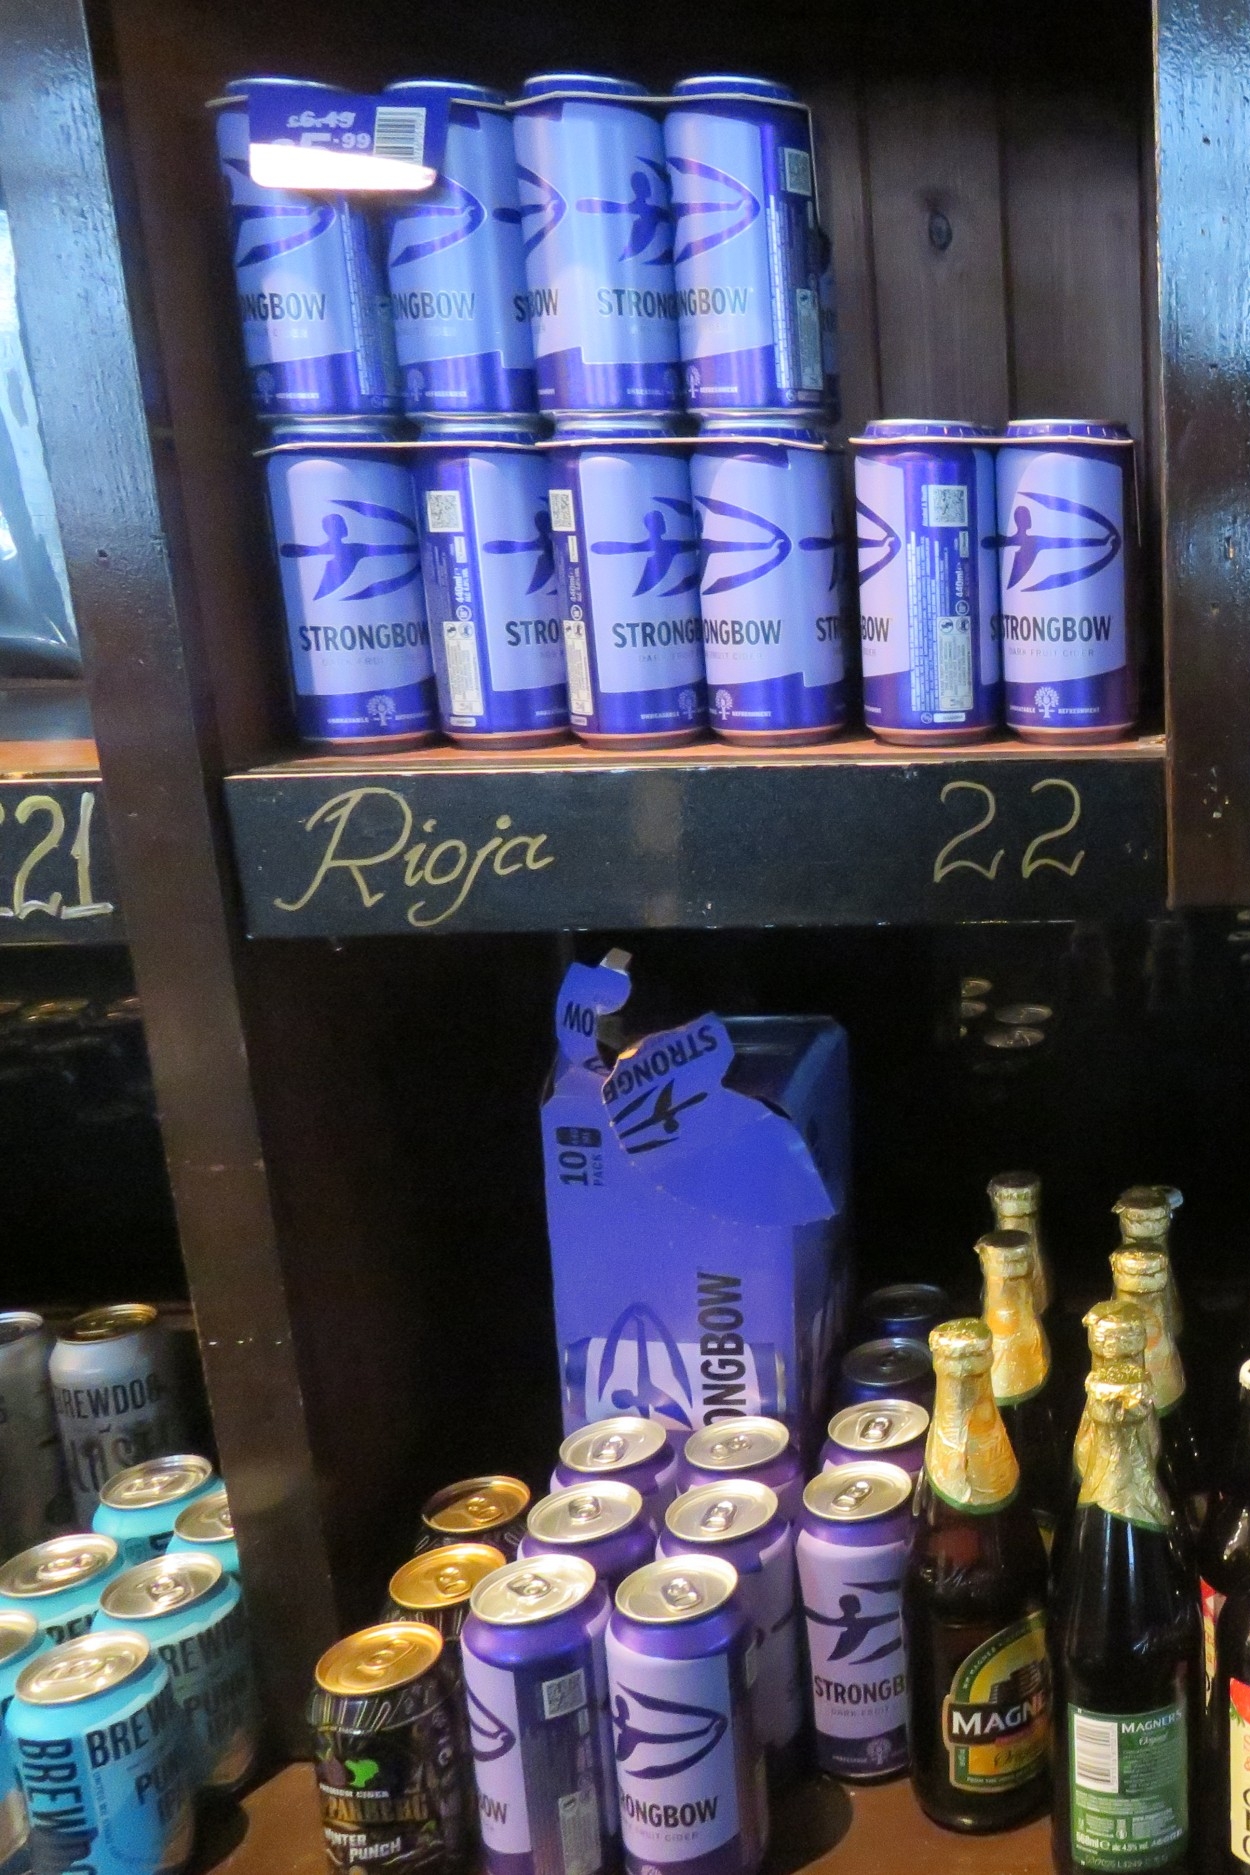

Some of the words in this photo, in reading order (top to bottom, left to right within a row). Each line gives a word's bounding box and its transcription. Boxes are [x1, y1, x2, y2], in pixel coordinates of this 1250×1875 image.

[274, 787, 554, 927] Rioja
[933, 778, 1085, 883] 22
[1120, 1709, 1183, 1734] MAGNERS
[349, 1835, 402, 1863] PUNCH
